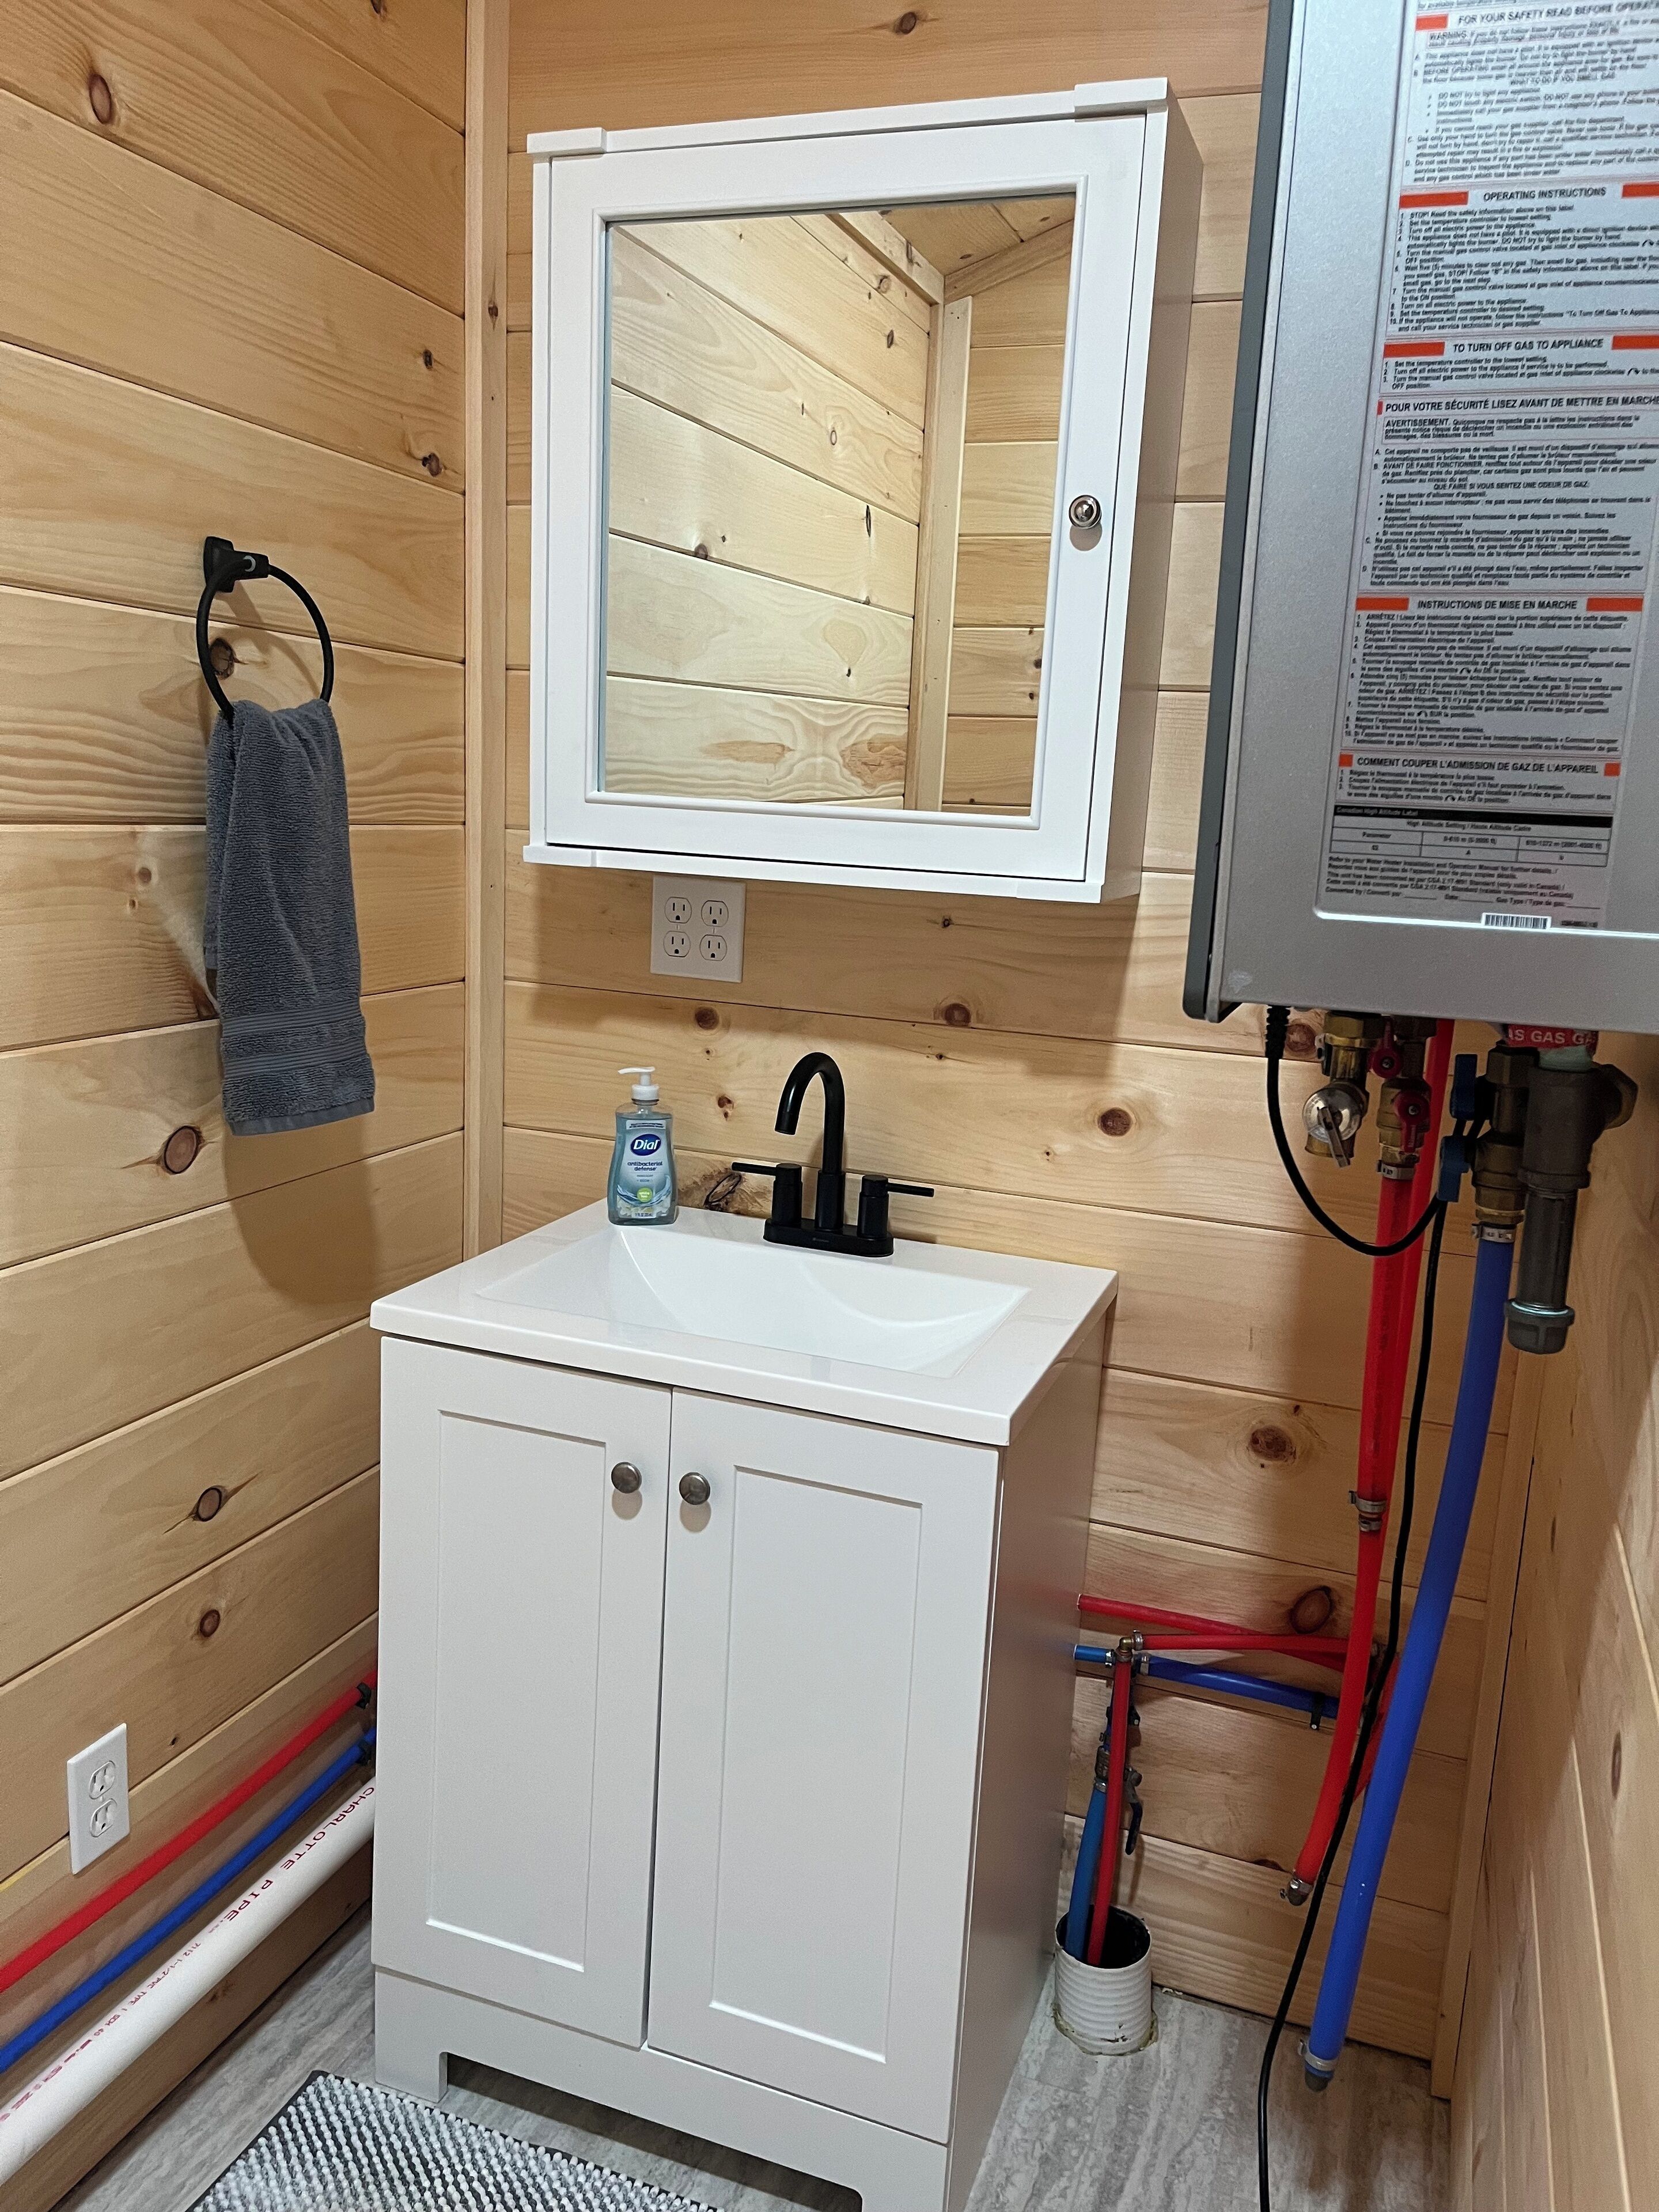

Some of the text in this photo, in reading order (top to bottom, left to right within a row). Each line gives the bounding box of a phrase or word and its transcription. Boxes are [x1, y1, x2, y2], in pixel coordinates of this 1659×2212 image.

[1458, 14, 1477, 24] FOR
[1480, 13, 1505, 22] YOUR
[1508, 10, 1543, 20] SAFETY
[1483, 188, 1606, 200] OPERATING INSTRUCTIONS
[1468, 343, 1491, 352] TURN
[1494, 343, 1511, 351] OFF
[1514, 342, 1533, 350] GAS
[1537, 341, 1548, 349] TO
[1551, 339, 1603, 349] APPLIANCE
[1385, 403, 1410, 411] POUR
[1412, 402, 1442, 410] VOTRE
[1445, 401, 1488, 410] SÉCURITÉ
[1491, 400, 1517, 408] LISEZ
[1518, 399, 1547, 408] AVANT
[1566, 398, 1603, 407] METTRE
[1606, 397, 1619, 406] EN
[1417, 600, 1577, 609] INSTRUCTIONS DE MISE EN MARCHE
[1357, 757, 1598, 774] COMMENT COUPER L'ADMISSION DE GAZ DE L'APPAREIL
[1531, 1031, 1565, 1044] GAS
[634, 1139, 658, 1150] Dial
[281, 1787, 374, 1870] CHARLOTTE
[129, 1991, 146, 2005] TYPE
